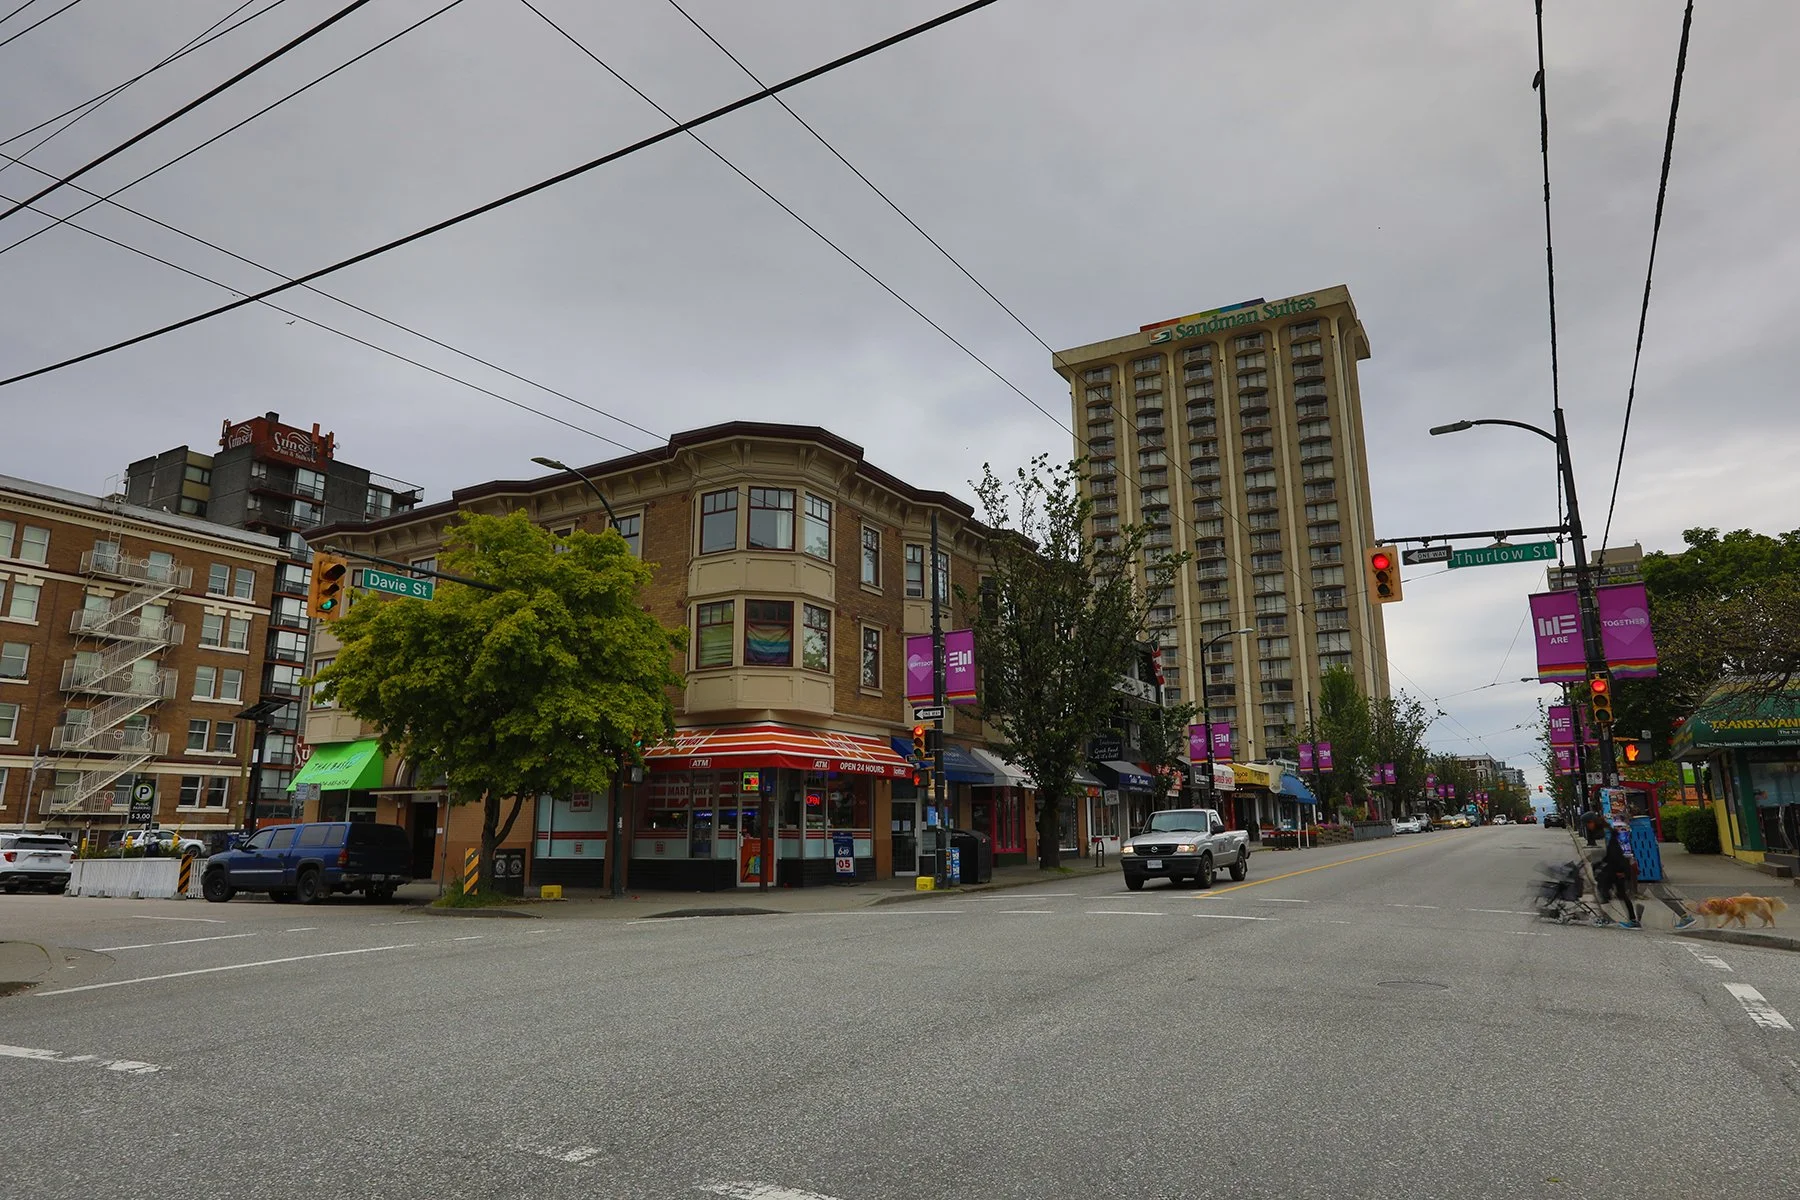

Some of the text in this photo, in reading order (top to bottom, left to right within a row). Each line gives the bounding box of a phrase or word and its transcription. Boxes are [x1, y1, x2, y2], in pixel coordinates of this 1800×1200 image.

[1175, 296, 1317, 340] Sandman Suites
[228, 429, 253, 449] Sunset
[1432, 550, 1447, 558] WAY
[1455, 545, 1549, 566] Thurlow St
[369, 573, 427, 597] Davie St
[1538, 614, 1578, 637] WE
[1602, 617, 1646, 627] TOGETHER
[1550, 636, 1569, 645] ARE
[691, 759, 709, 767] ATM
[814, 760, 828, 769] ATM
[839, 761, 885, 774] OPEN 24 HOURS
[139, 786, 149, 799] P
[805, 795, 821, 806] OPEN
